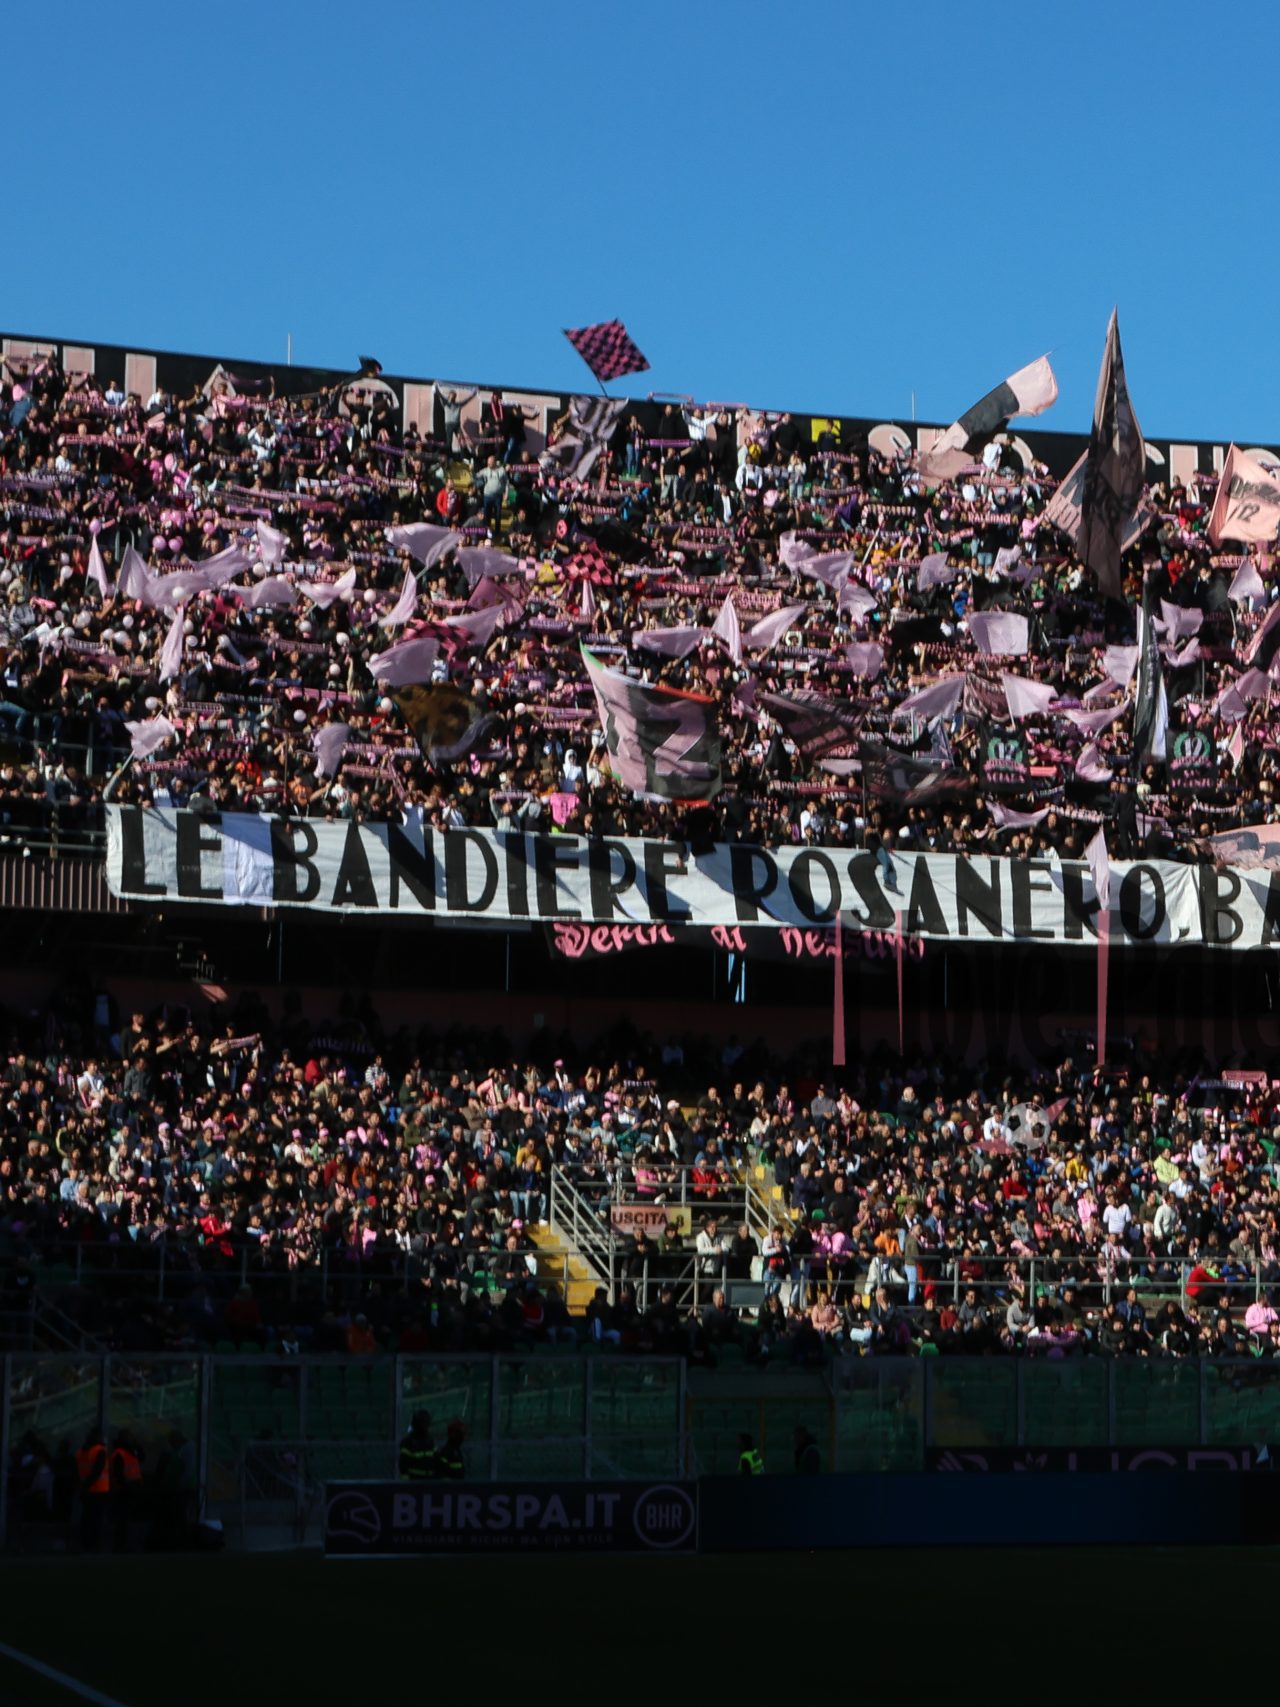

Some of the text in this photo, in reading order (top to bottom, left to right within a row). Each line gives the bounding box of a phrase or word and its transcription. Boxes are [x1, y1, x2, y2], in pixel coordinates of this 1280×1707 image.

[121, 808, 223, 899] LE
[270, 818, 694, 922] BANDIERE
[612, 1210, 667, 1225] USCITA
[392, 1492, 683, 1530] BHRSPA.IT BHR
